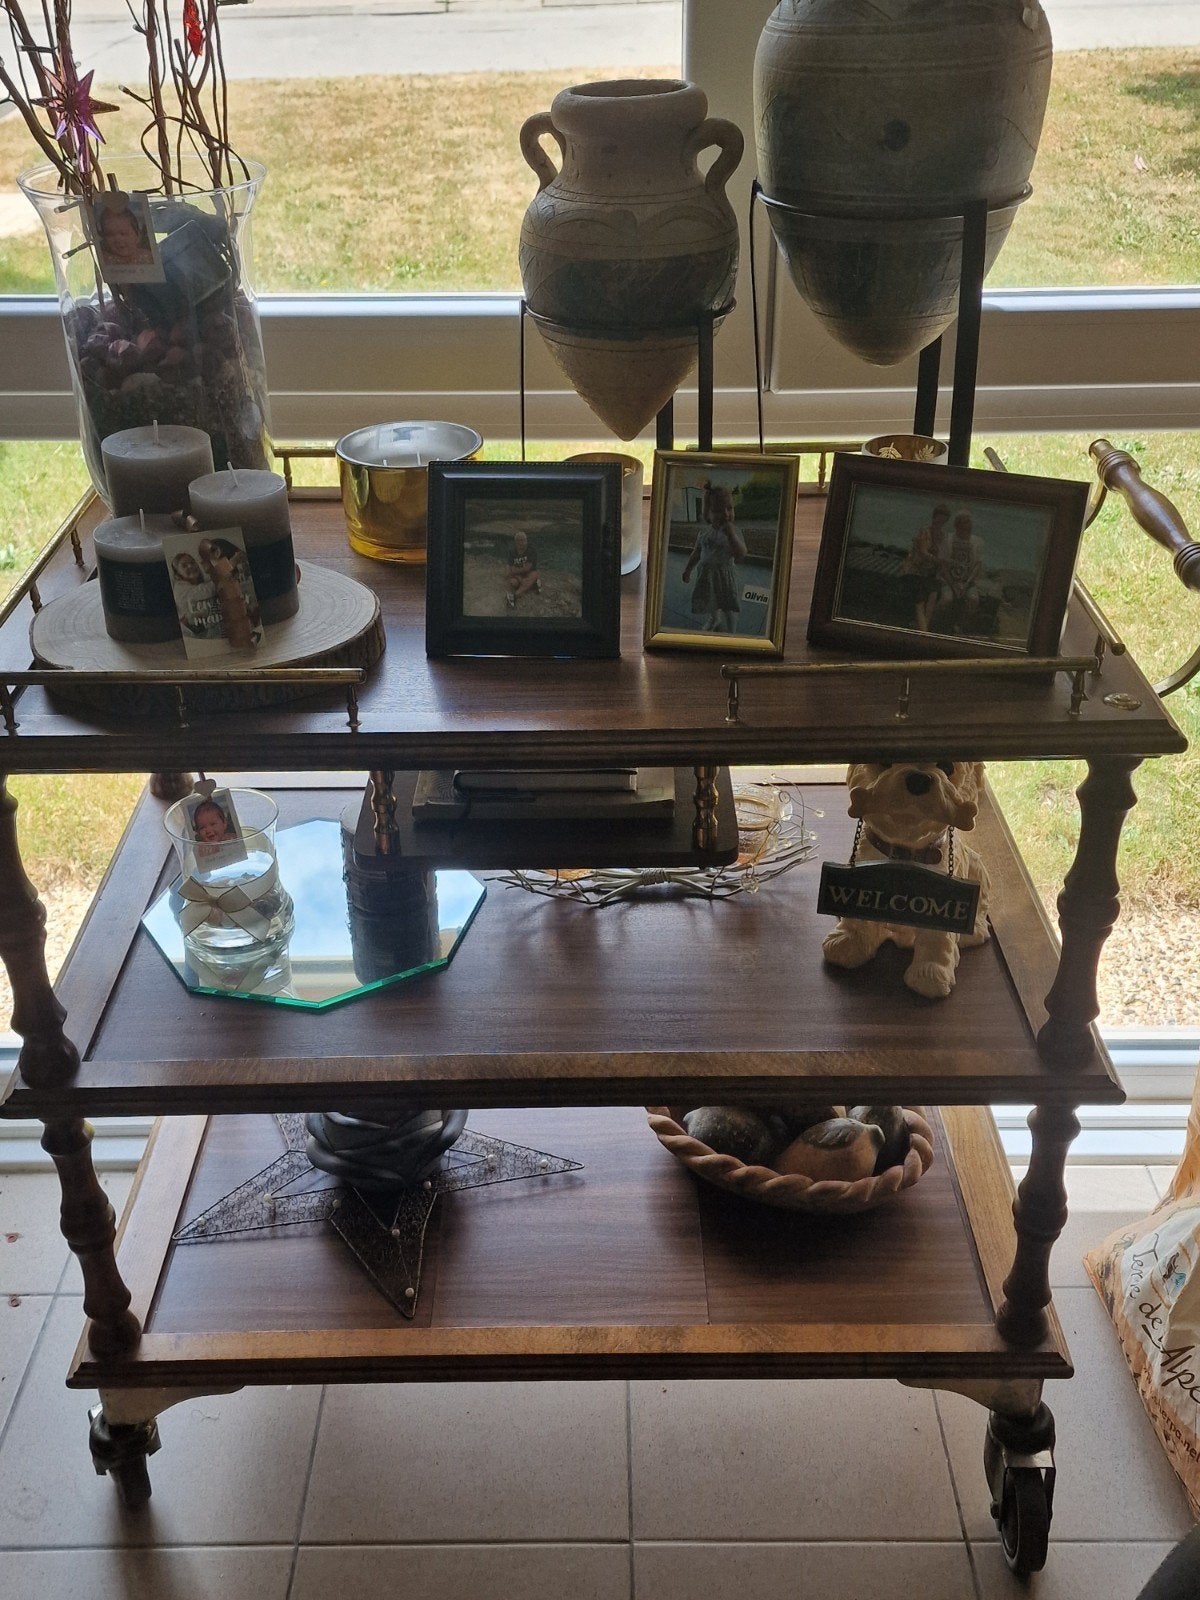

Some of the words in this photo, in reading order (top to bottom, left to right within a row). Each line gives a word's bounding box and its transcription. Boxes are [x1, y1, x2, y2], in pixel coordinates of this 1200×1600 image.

[744, 591, 769, 603] Olivia
[827, 885, 970, 920] WELCOME
[1138, 1302, 1162, 1330] de
